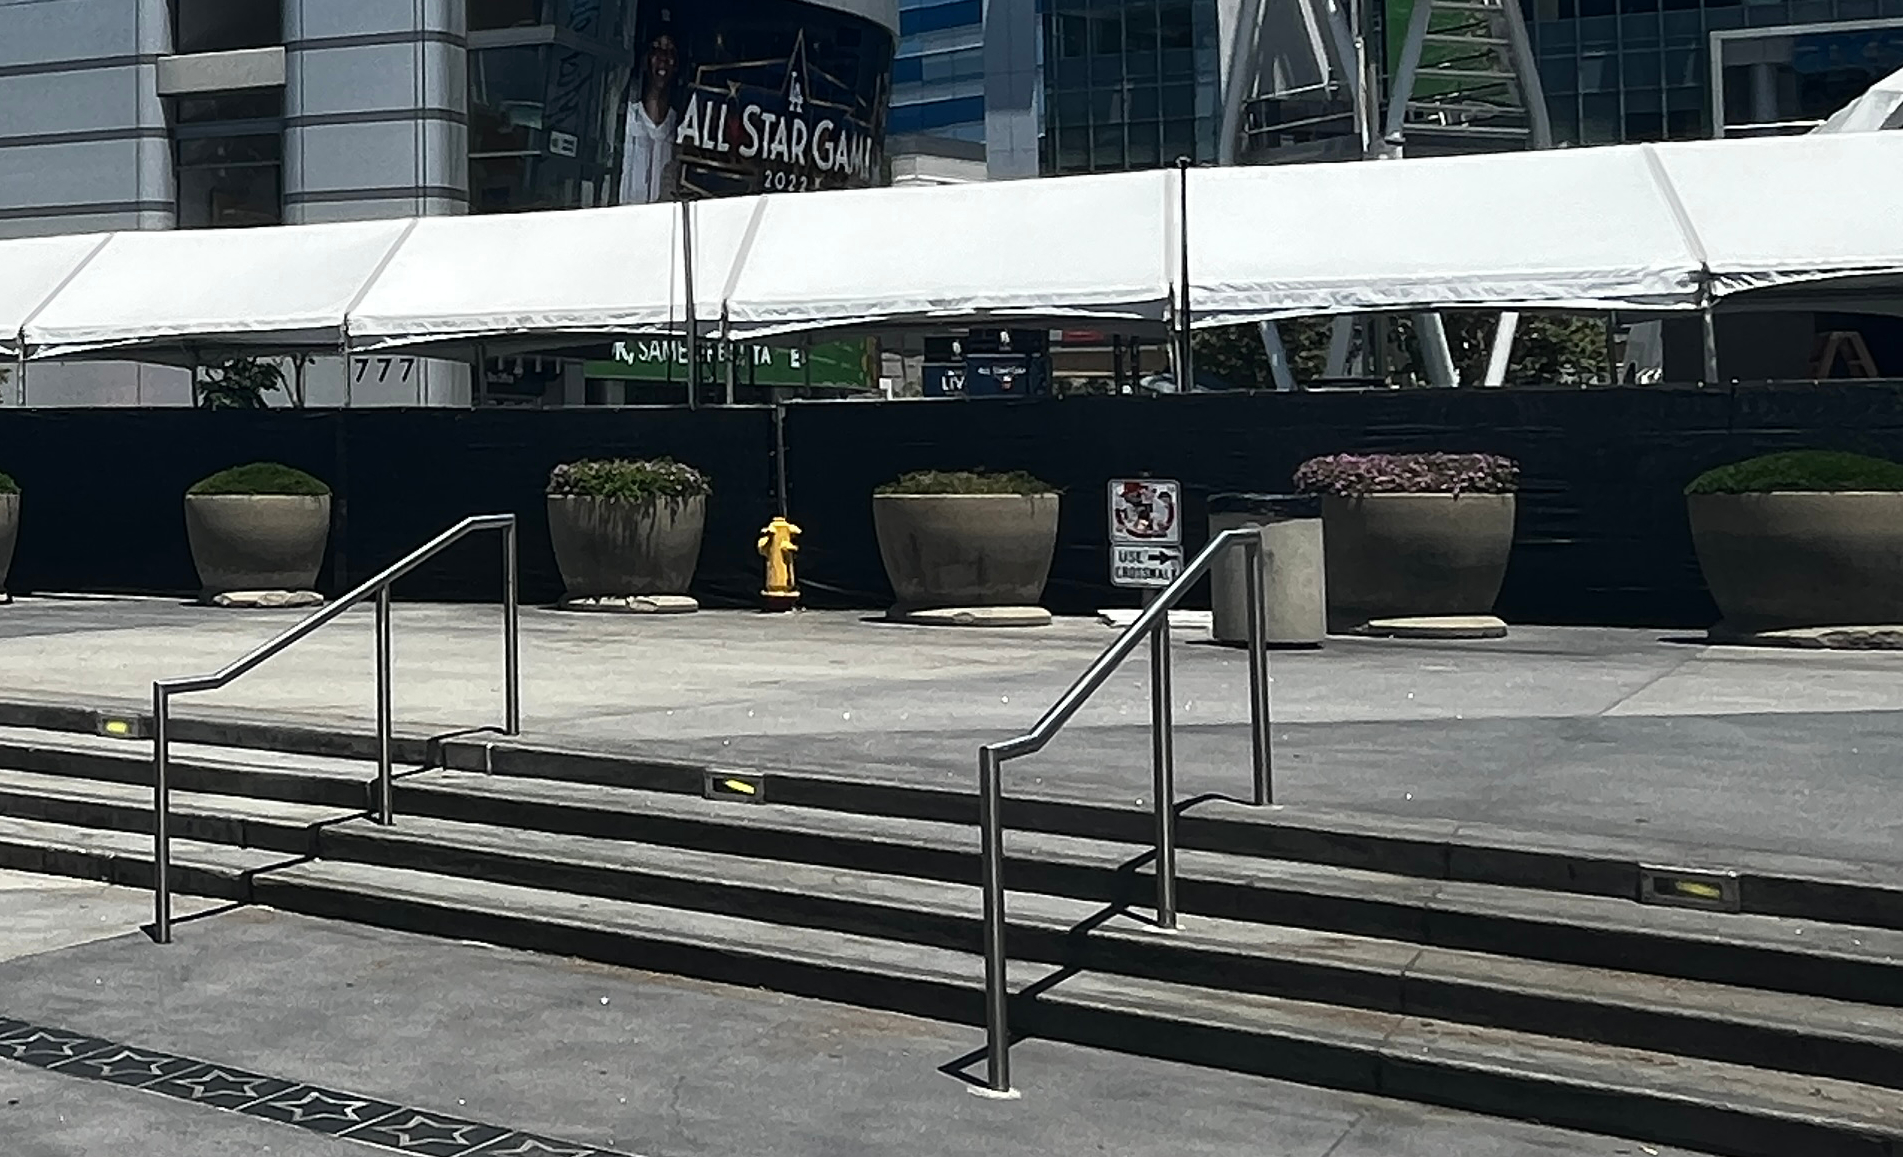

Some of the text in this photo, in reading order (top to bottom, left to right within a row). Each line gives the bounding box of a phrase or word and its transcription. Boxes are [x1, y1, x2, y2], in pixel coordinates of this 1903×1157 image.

[676, 92, 730, 152] ALL
[739, 105, 808, 166] STAR
[354, 357, 416, 383] 777
